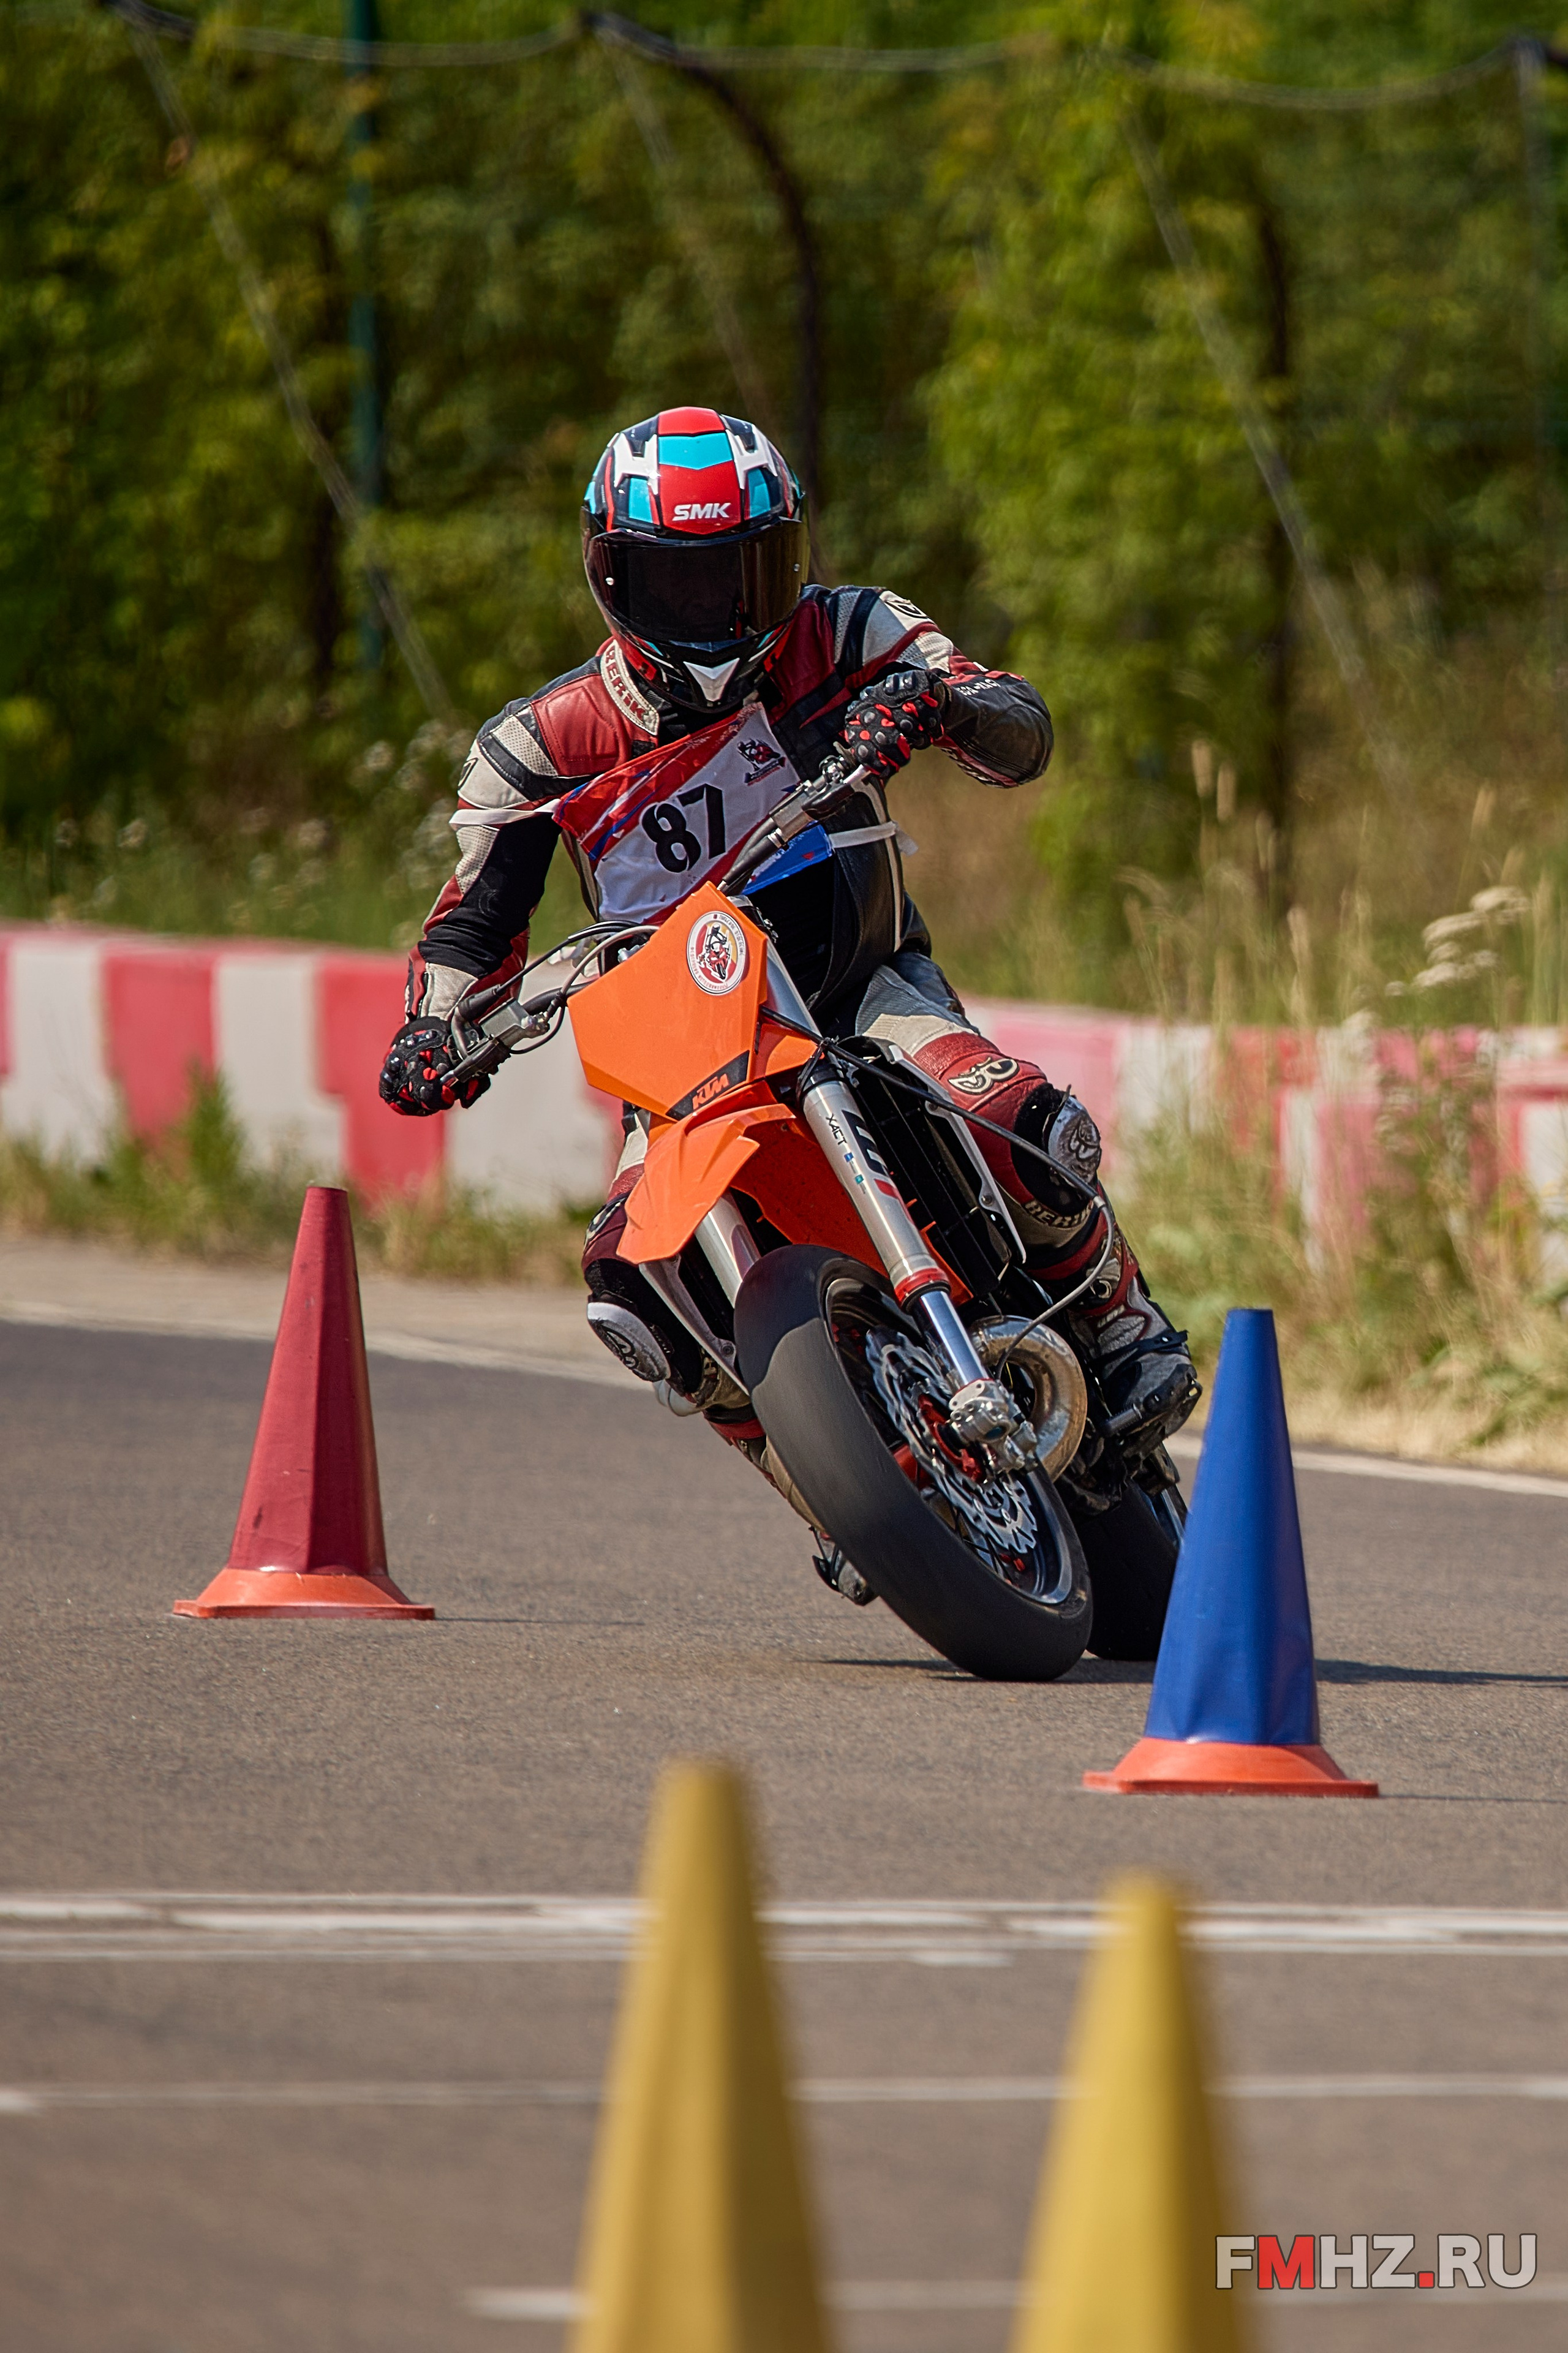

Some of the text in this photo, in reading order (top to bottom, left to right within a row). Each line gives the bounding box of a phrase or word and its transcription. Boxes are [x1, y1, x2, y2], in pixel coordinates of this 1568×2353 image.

[672, 502, 731, 521] SMK
[641, 782, 726, 874] 87
[692, 1073, 729, 1110] KTM
[825, 1112, 848, 1146] XACT
